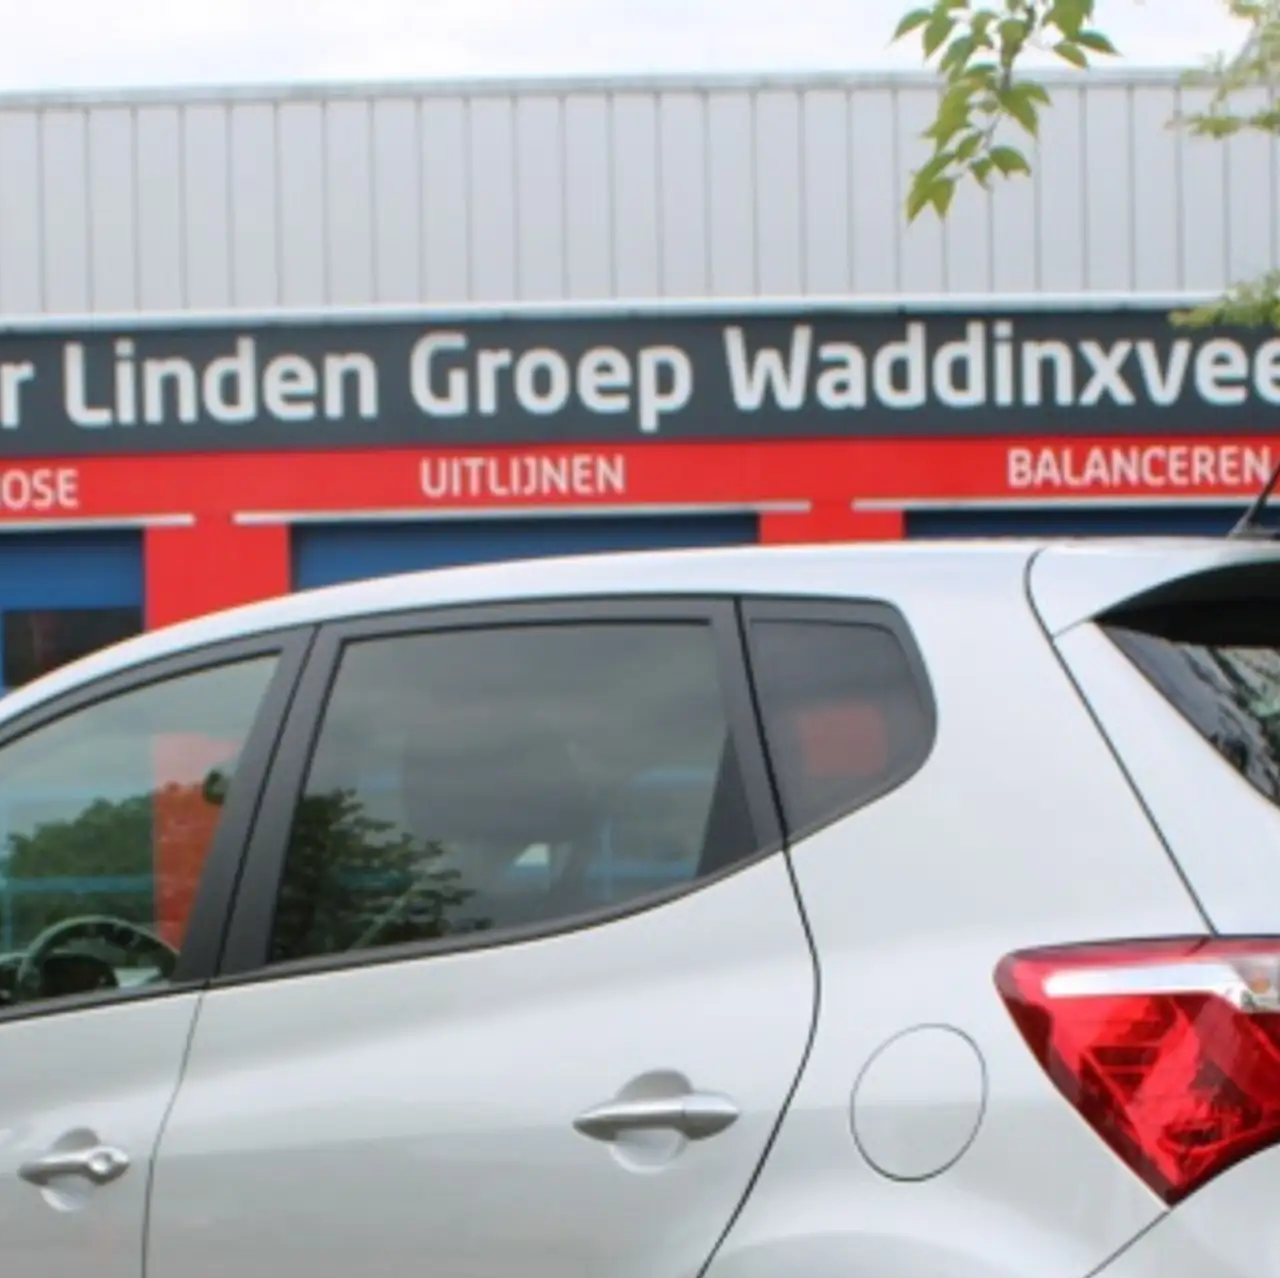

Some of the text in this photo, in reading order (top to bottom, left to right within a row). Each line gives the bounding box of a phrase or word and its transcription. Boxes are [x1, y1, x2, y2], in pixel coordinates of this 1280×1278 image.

[64, 335, 379, 428] Linden
[410, 333, 693, 432] Groep
[420, 453, 626, 498] UITLIJNEN
[1006, 444, 1272, 488] BALANCEREN
